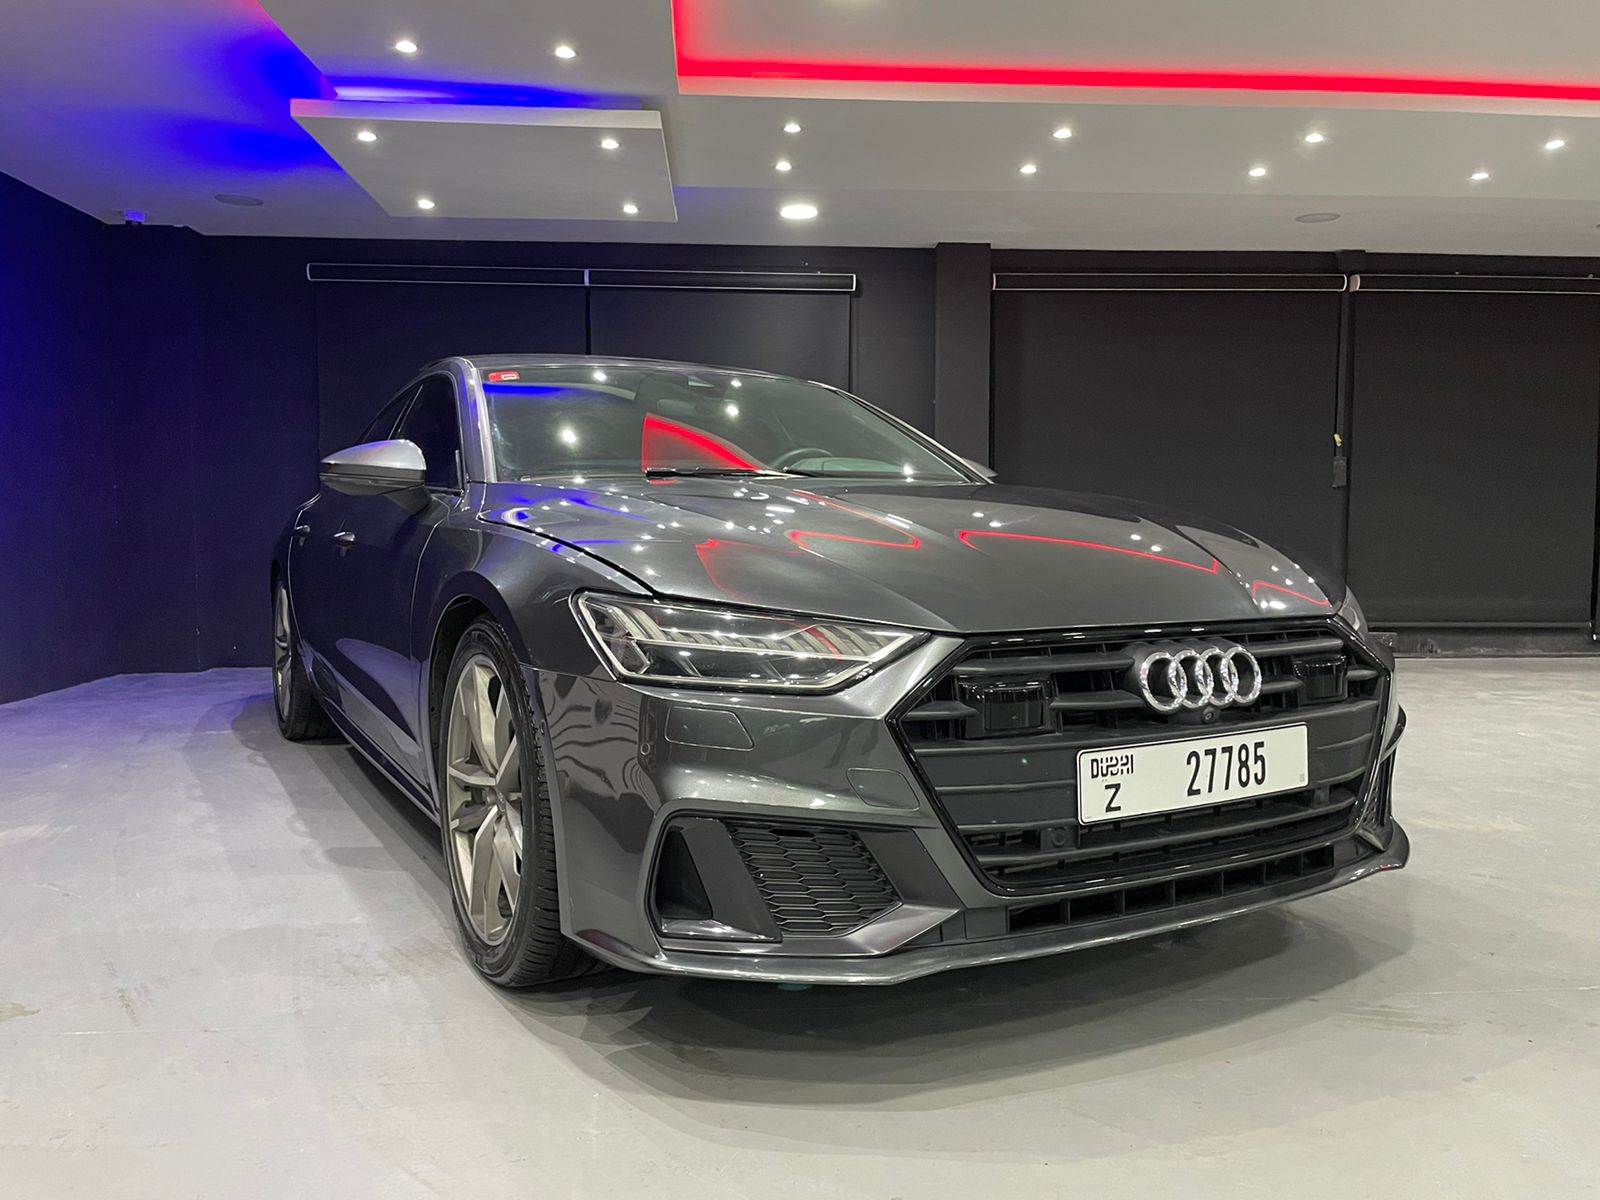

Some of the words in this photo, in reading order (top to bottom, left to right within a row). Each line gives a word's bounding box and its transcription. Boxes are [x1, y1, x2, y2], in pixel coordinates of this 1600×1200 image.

[1090, 754, 1134, 779] DUBAI
[1186, 741, 1266, 796] 27785
[1104, 783, 1121, 812] Z
